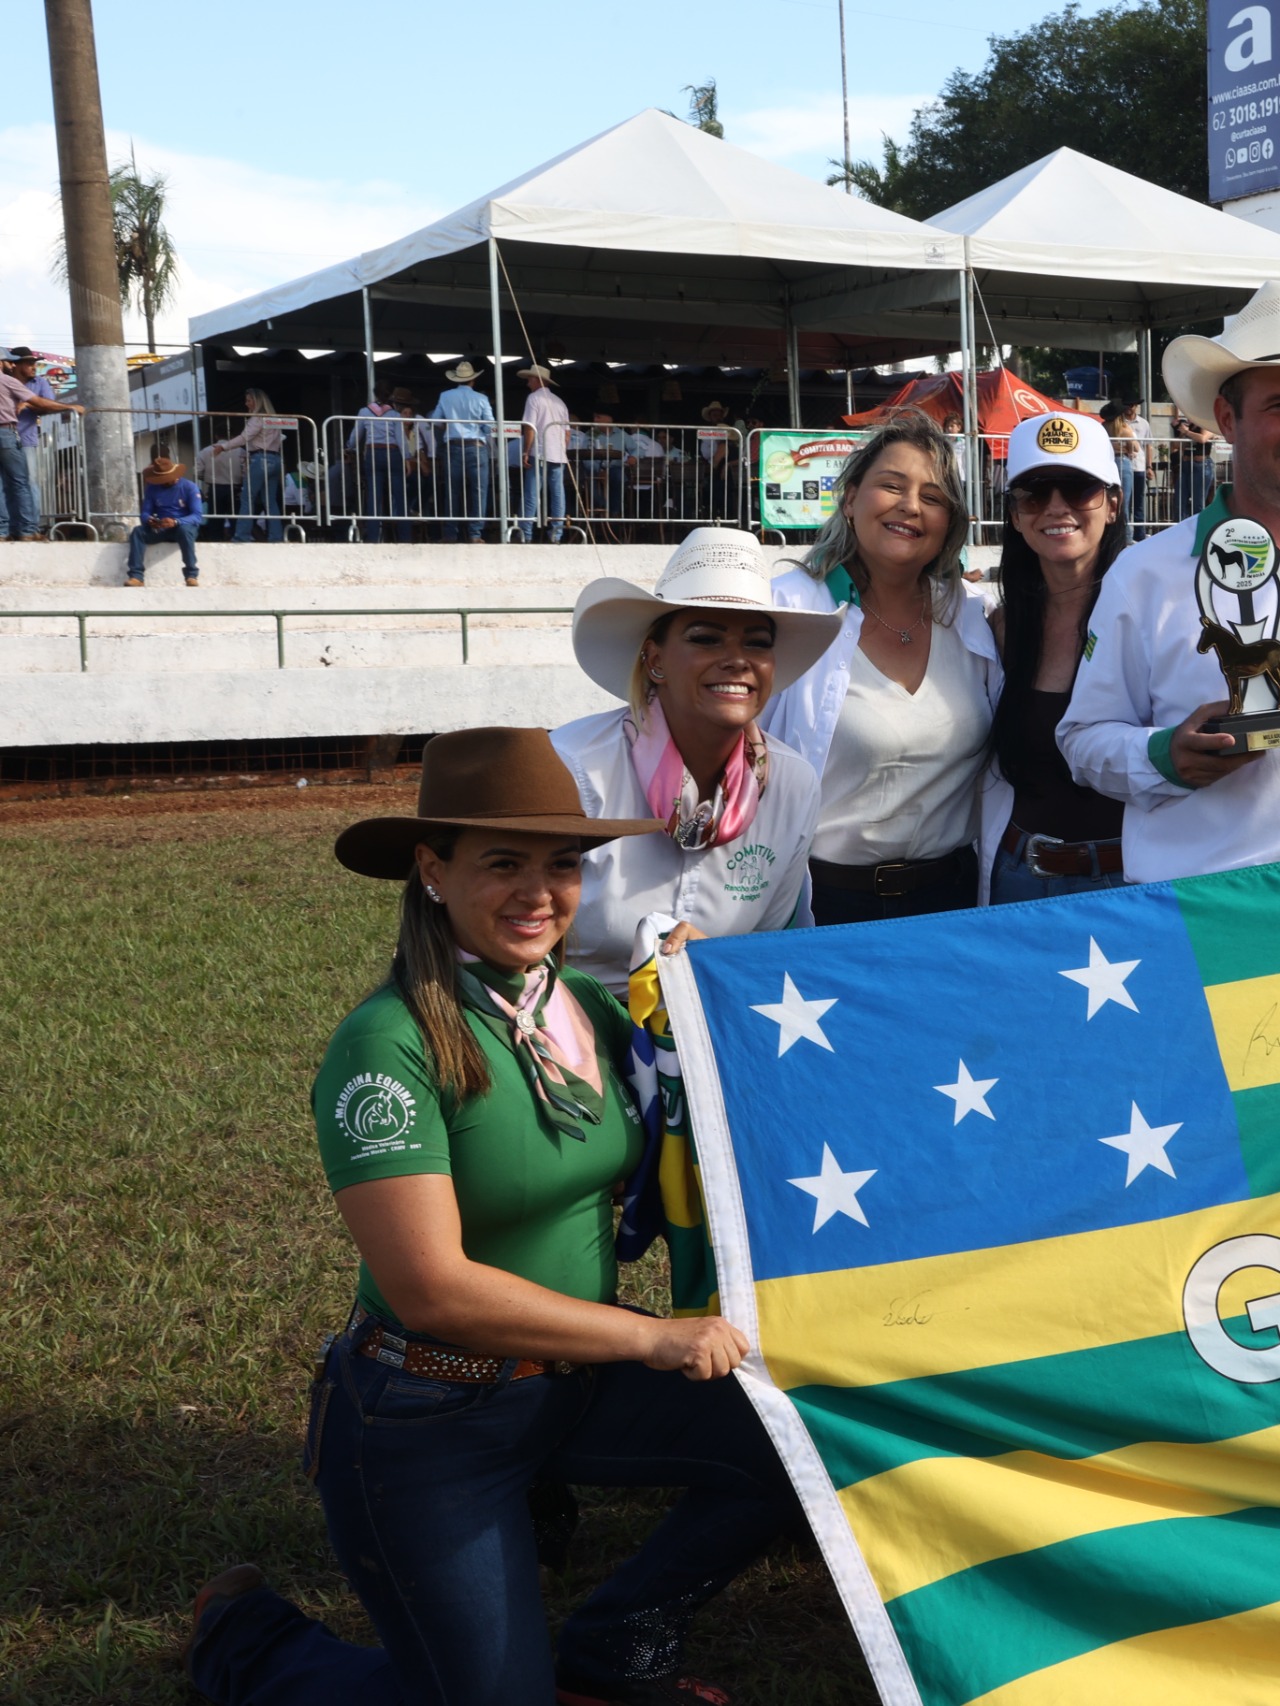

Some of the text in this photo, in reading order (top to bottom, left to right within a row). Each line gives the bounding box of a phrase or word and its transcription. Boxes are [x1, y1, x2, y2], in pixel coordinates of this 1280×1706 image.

[1212, 112, 1227, 131] 62
[1230, 125, 1267, 143] @curtaciaasa
[799, 443, 835, 456] COMITIVA
[1042, 437, 1074, 446] PRIME
[726, 844, 776, 870] COMITIVA
[724, 883, 750, 892] Rancho
[335, 1072, 416, 1119] MEDICINA EQUINA
